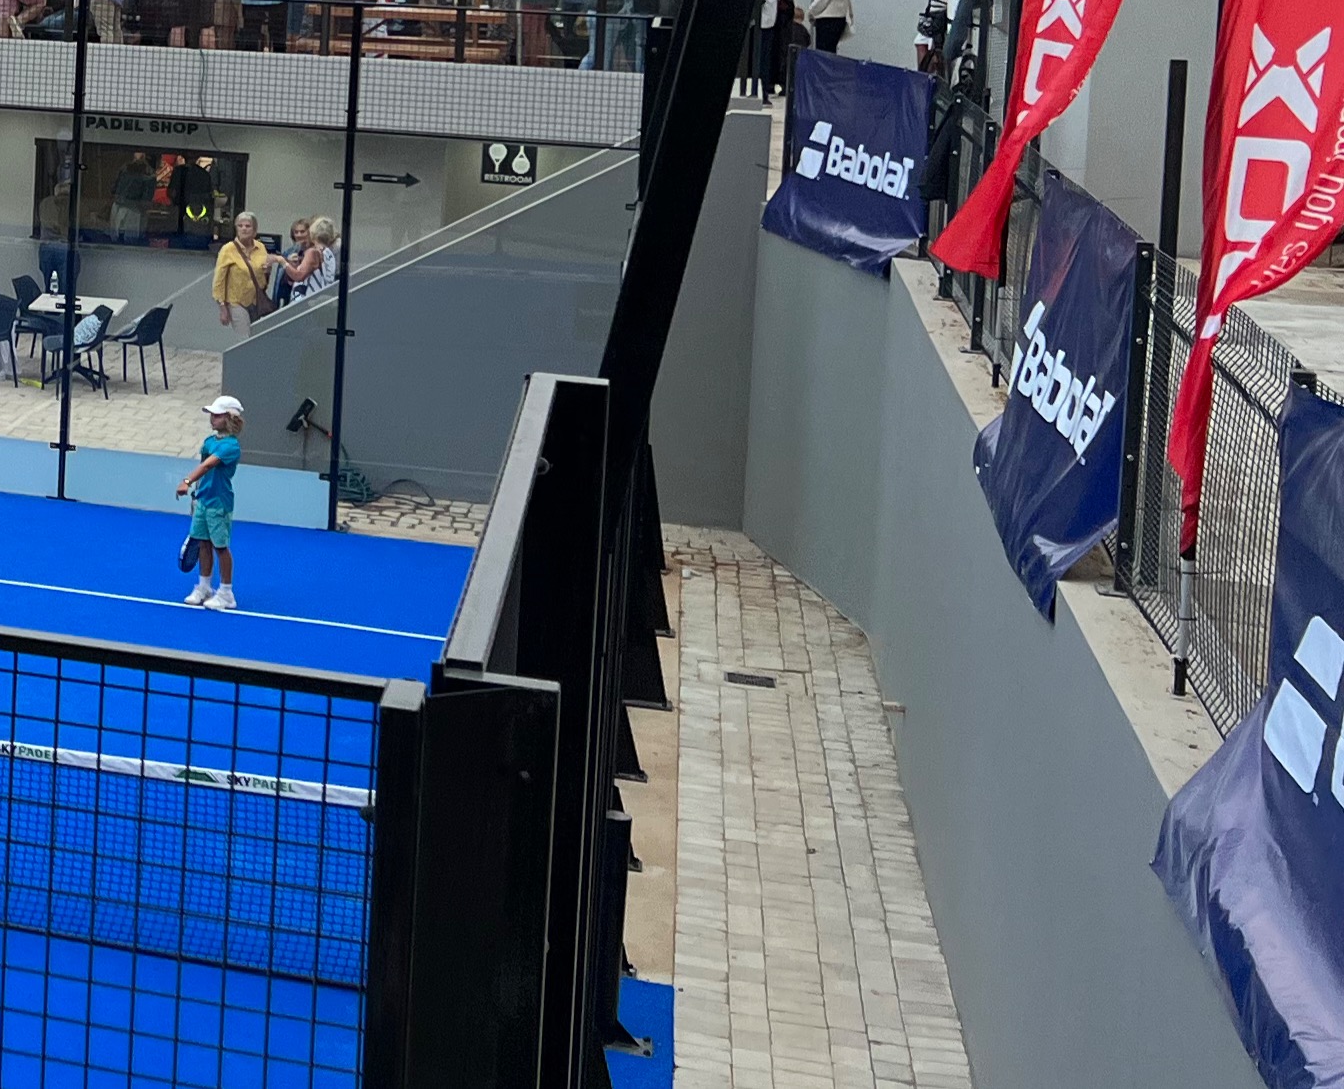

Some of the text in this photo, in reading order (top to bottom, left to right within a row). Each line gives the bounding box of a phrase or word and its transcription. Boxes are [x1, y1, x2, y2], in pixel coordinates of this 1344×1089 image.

[85, 116, 199, 135] PADEL SHOP
[825, 135, 914, 199] Babolat
[484, 173, 533, 185] RESTROOM
